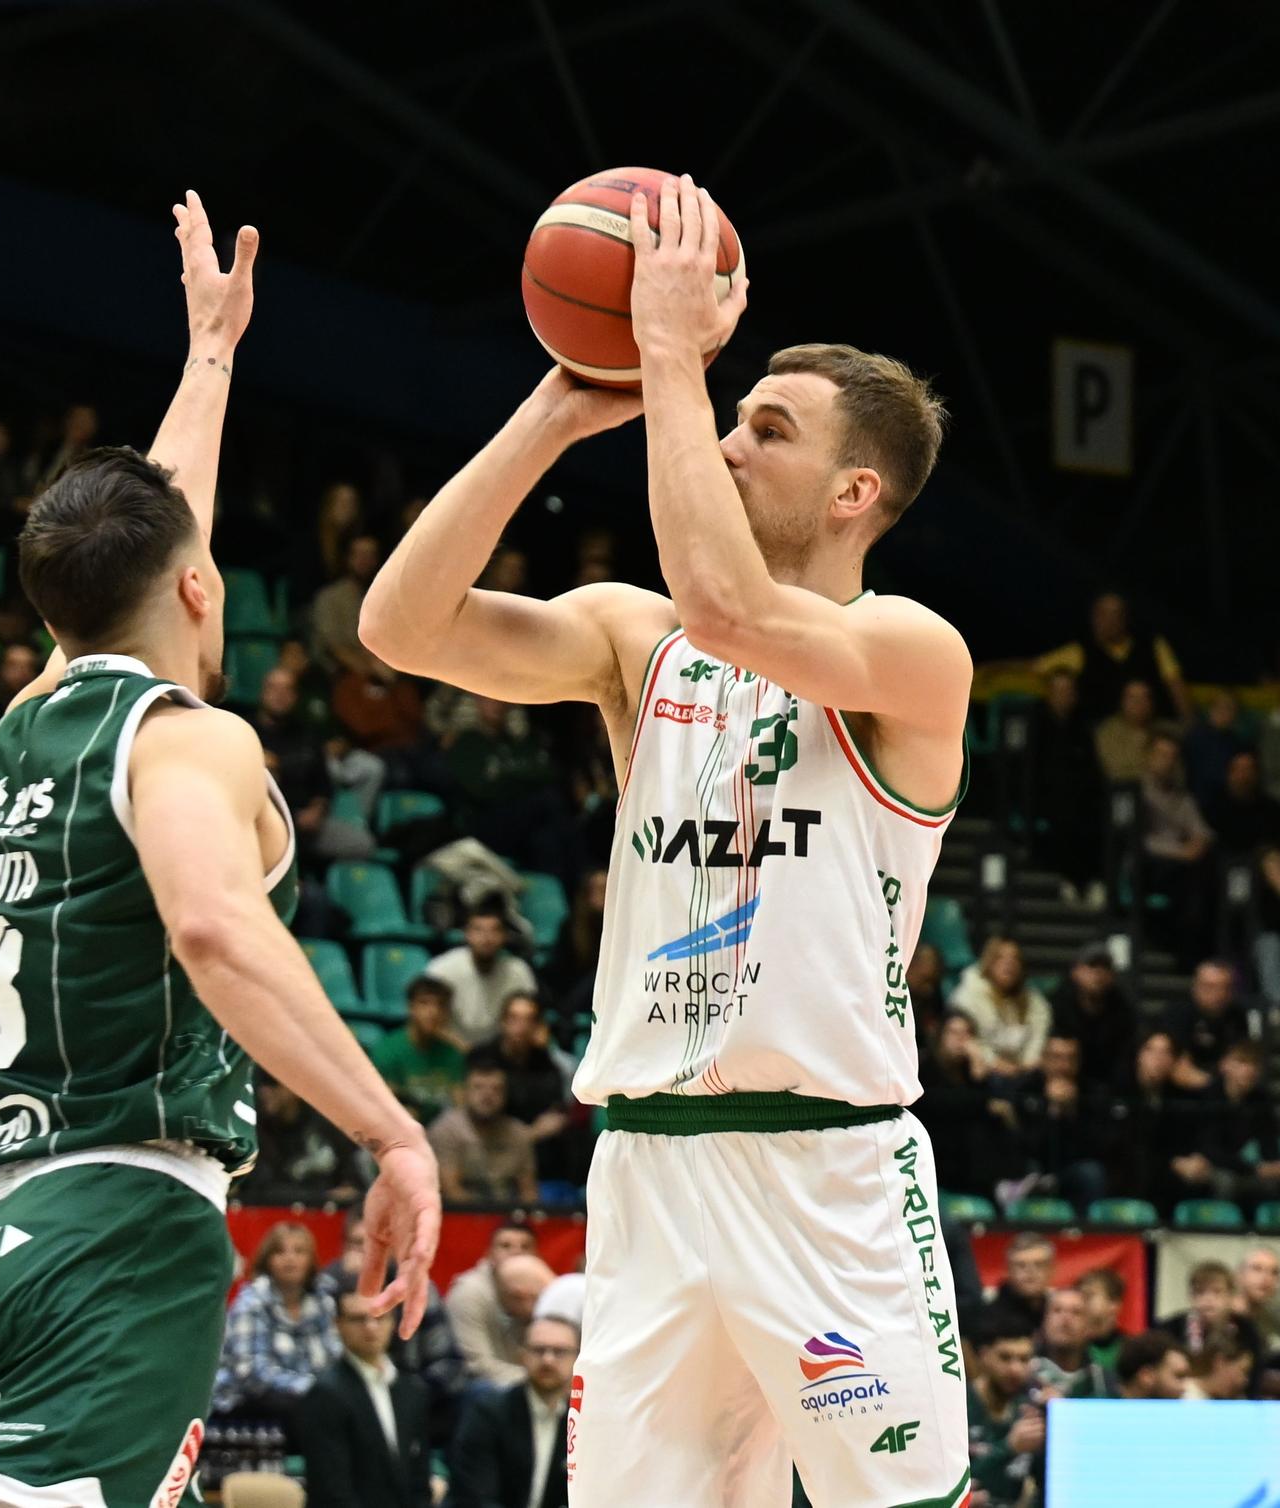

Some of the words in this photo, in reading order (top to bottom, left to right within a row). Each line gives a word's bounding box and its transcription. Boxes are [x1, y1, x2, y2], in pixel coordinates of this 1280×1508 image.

[1074, 362, 1112, 447] P
[644, 961, 762, 994] WROCW
[647, 994, 749, 1026] AIRPOT
[894, 1136, 962, 1382] WROCŁAW
[800, 1378, 891, 1413] aquapark
[869, 1420, 921, 1454] 4F
